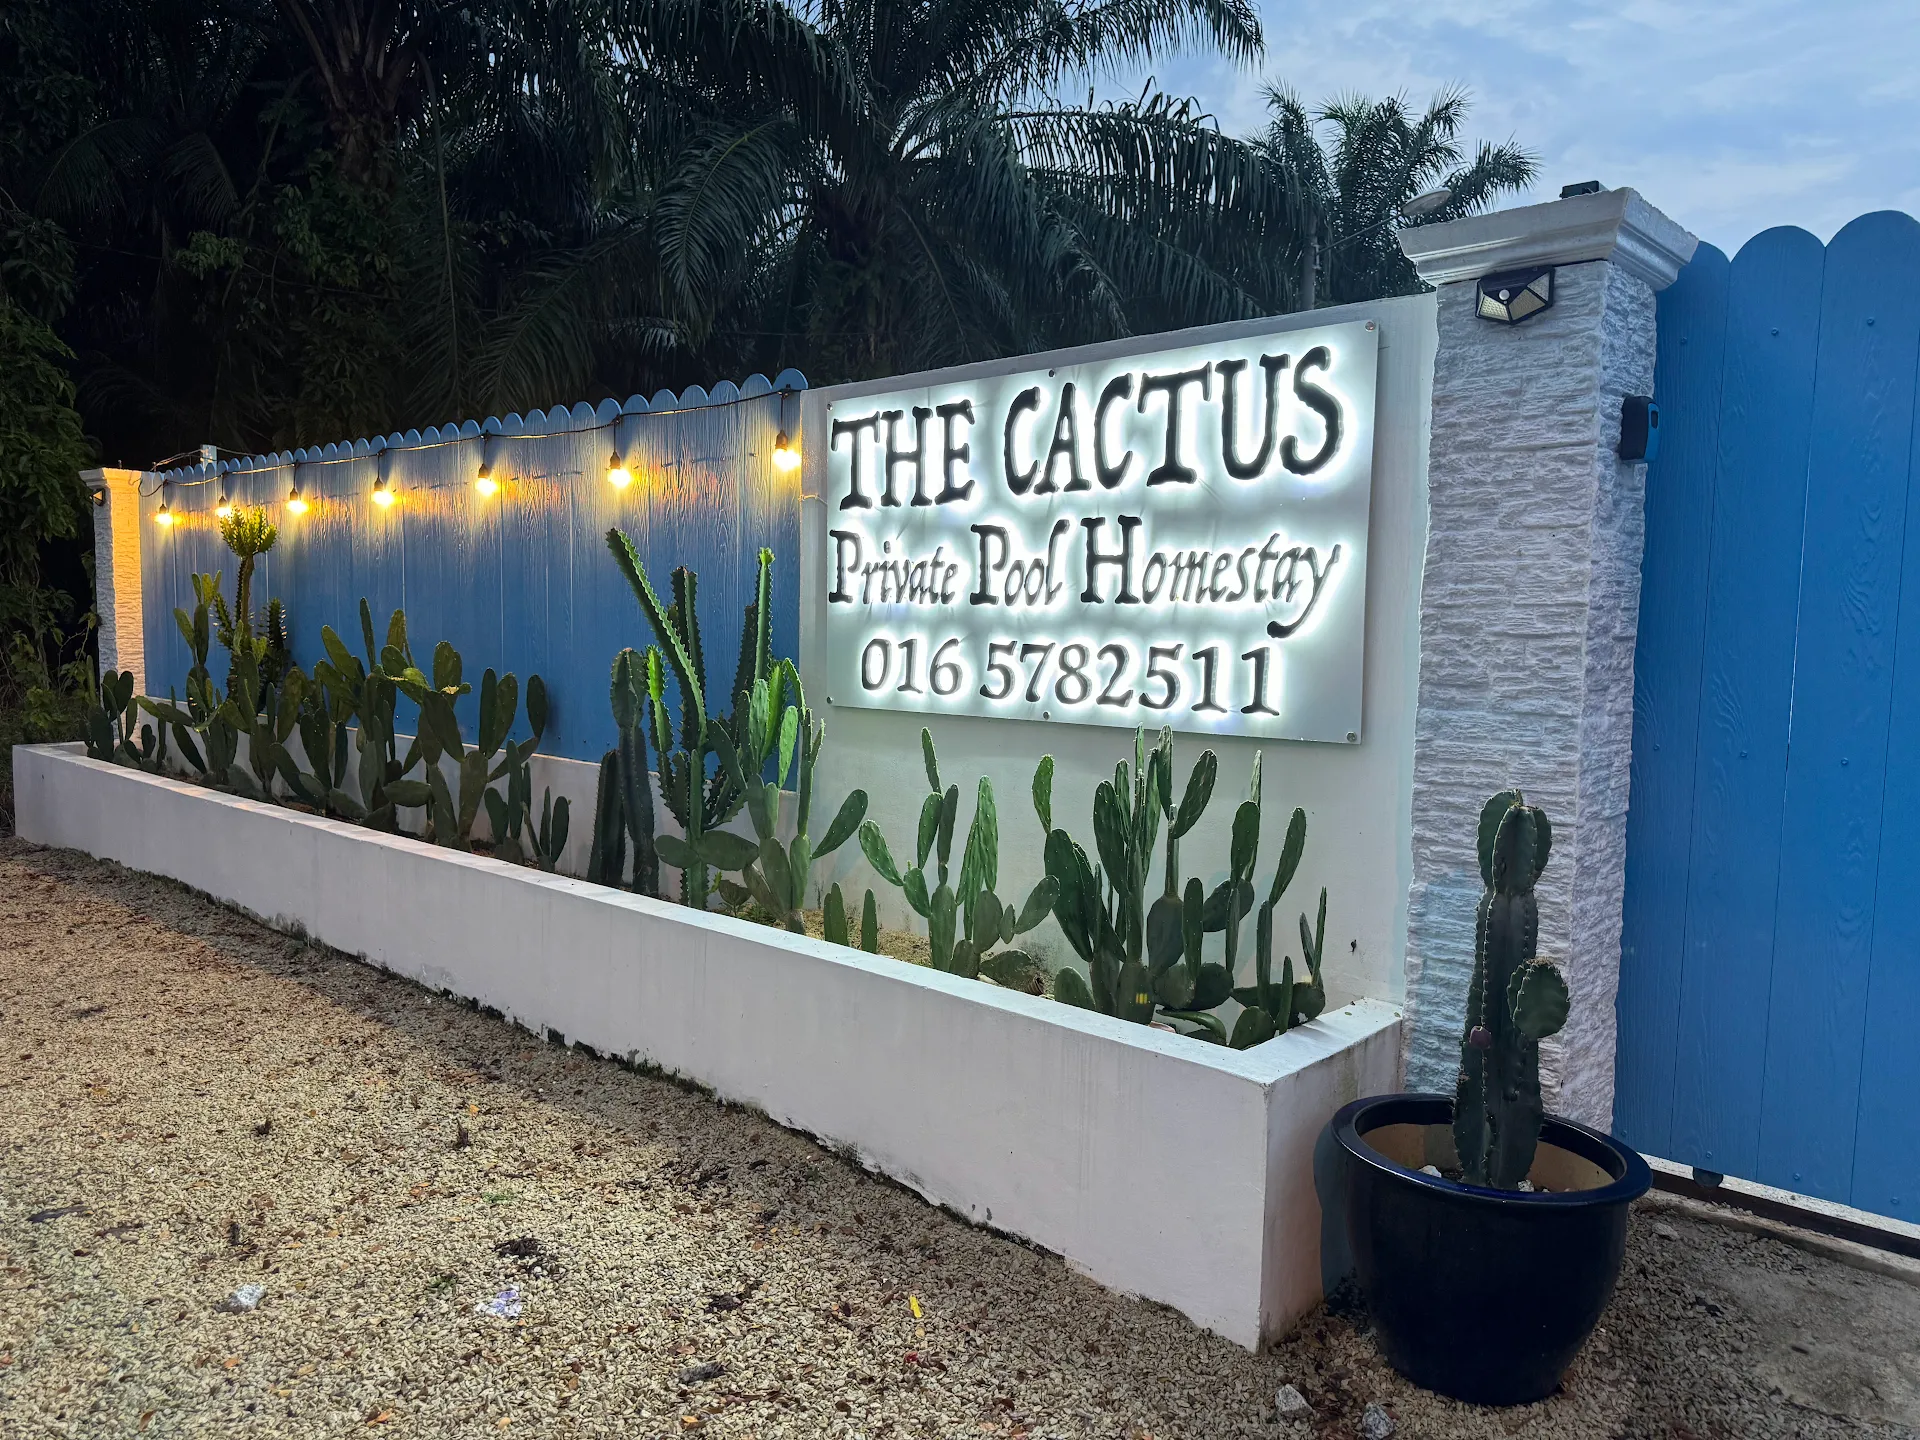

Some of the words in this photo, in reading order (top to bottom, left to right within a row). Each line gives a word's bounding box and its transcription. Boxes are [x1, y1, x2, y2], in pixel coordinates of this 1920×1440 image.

[830, 399, 975, 511] THE
[1003, 345, 1344, 496] CACTUS
[828, 529, 959, 605] Private
[969, 518, 1070, 606] Pool
[1080, 514, 1342, 639] Homestay
[861, 637, 963, 696] 016
[979, 640, 1280, 716] 5782511
